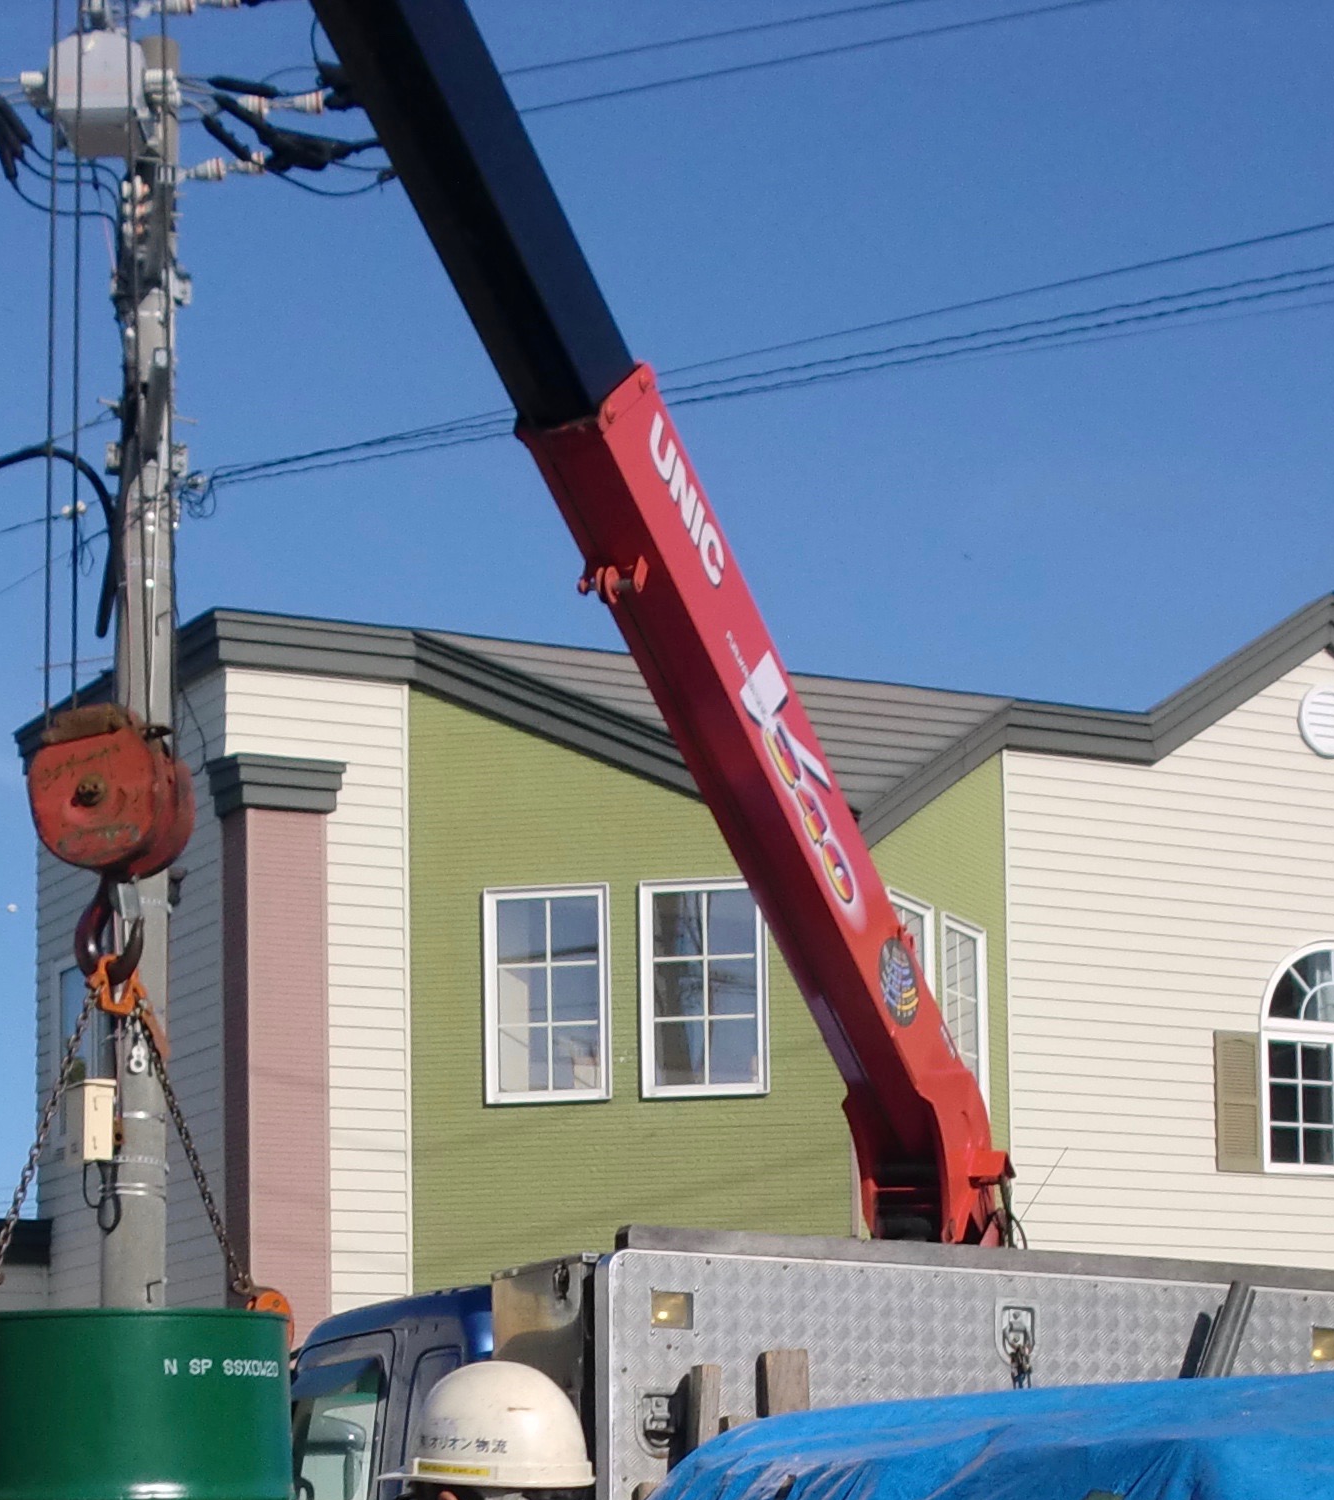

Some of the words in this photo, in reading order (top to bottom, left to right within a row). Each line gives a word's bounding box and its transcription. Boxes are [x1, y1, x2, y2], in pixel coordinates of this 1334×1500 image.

[649, 411, 724, 588] UNIC
[764, 722, 854, 904] 340
[163, 1359, 178, 1375] N
[189, 1358, 213, 1375] SP
